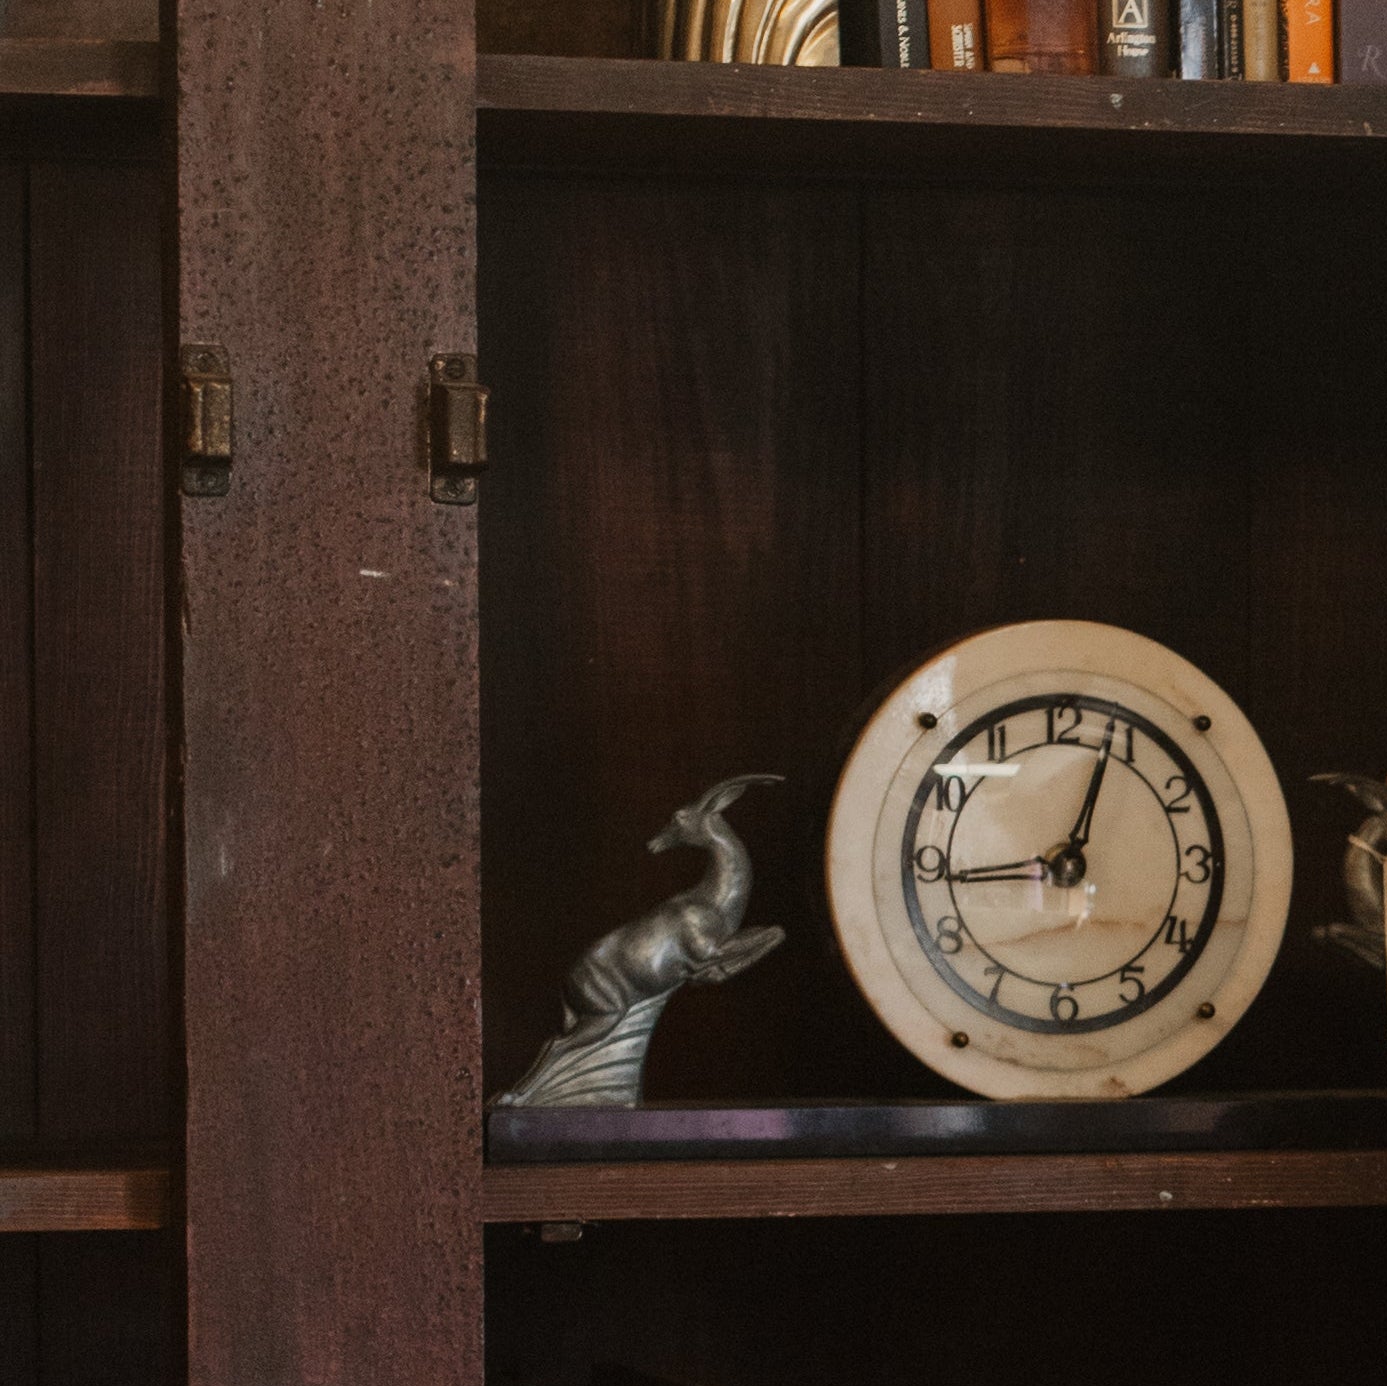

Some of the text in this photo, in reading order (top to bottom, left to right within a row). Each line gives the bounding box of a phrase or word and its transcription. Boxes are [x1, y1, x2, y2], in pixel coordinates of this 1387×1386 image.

[897, 25, 909, 36] &
[1106, 31, 1156, 45] Arlington
[899, 37, 911, 68] NOBLE
[965, 51, 976, 69] AND
[1046, 705, 1082, 744] 12
[1124, 721, 1136, 762] 1
[987, 725, 1006, 761] 11
[934, 775, 966, 812] 10
[1166, 776, 1195, 813] 2
[915, 845, 948, 883] 9
[1183, 845, 1211, 883] 3
[938, 916, 963, 954] 8
[1164, 916, 1194, 952] 4
[984, 969, 1006, 1002] 7
[1120, 966, 1145, 1003] 5
[1049, 986, 1079, 1022] 6
